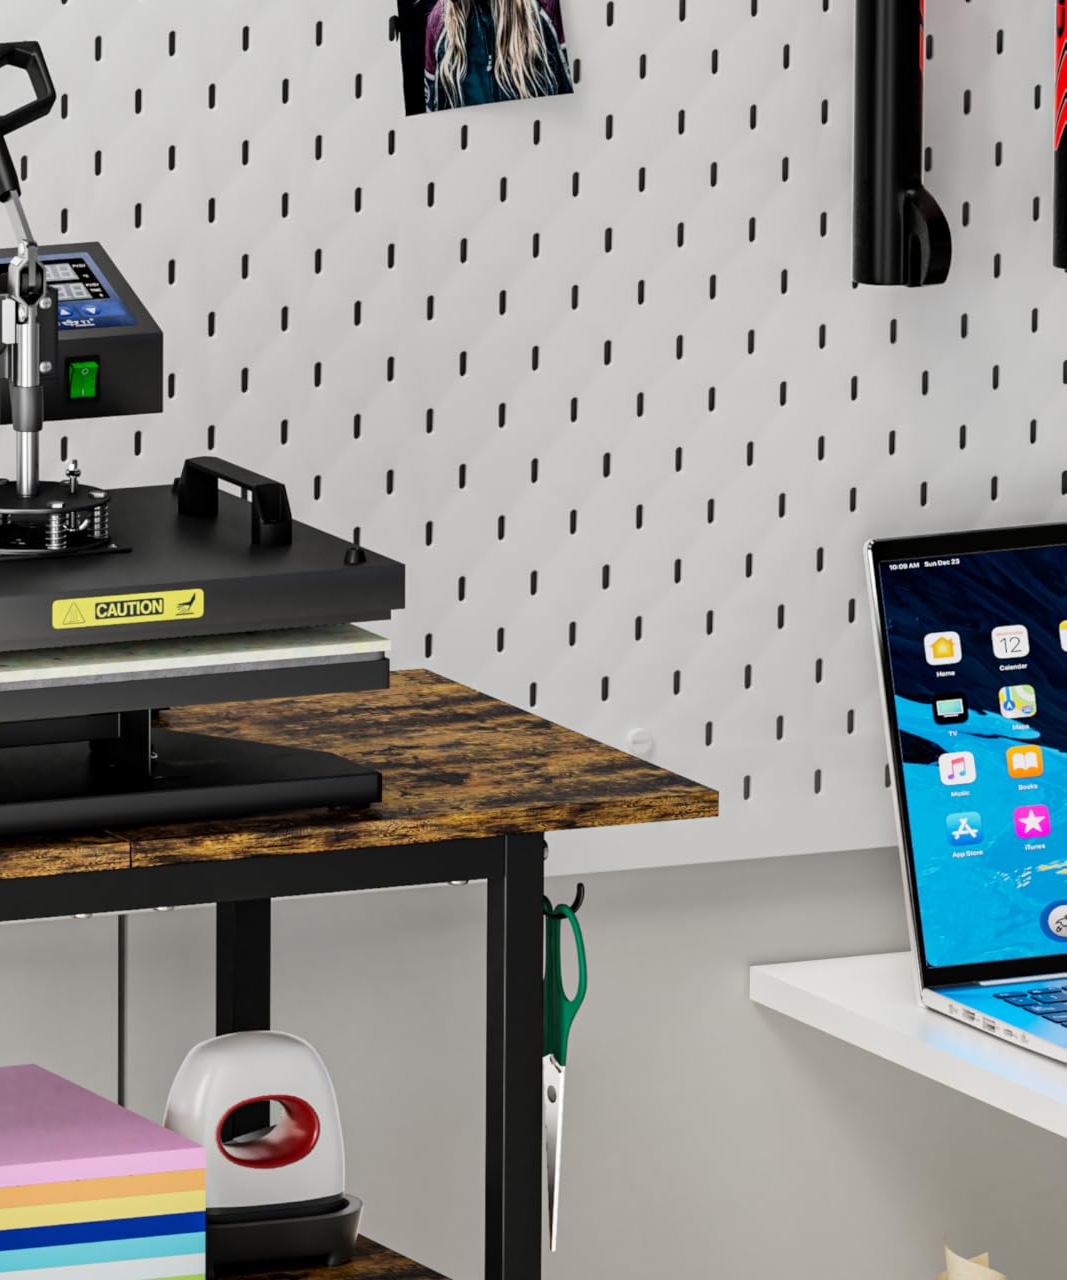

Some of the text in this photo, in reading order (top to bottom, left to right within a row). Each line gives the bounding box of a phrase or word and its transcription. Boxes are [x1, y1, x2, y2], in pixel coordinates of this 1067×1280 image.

[889, 563, 908, 571] 10:09
[96, 599, 163, 618] CAUTION
[999, 636, 1022, 653] 12
[998, 663, 1028, 671] Calendar
[936, 670, 955, 678] Home
[1018, 783, 1038, 791] Books
[1025, 843, 1046, 851] iTunes
[965, 849, 983, 857] Store
